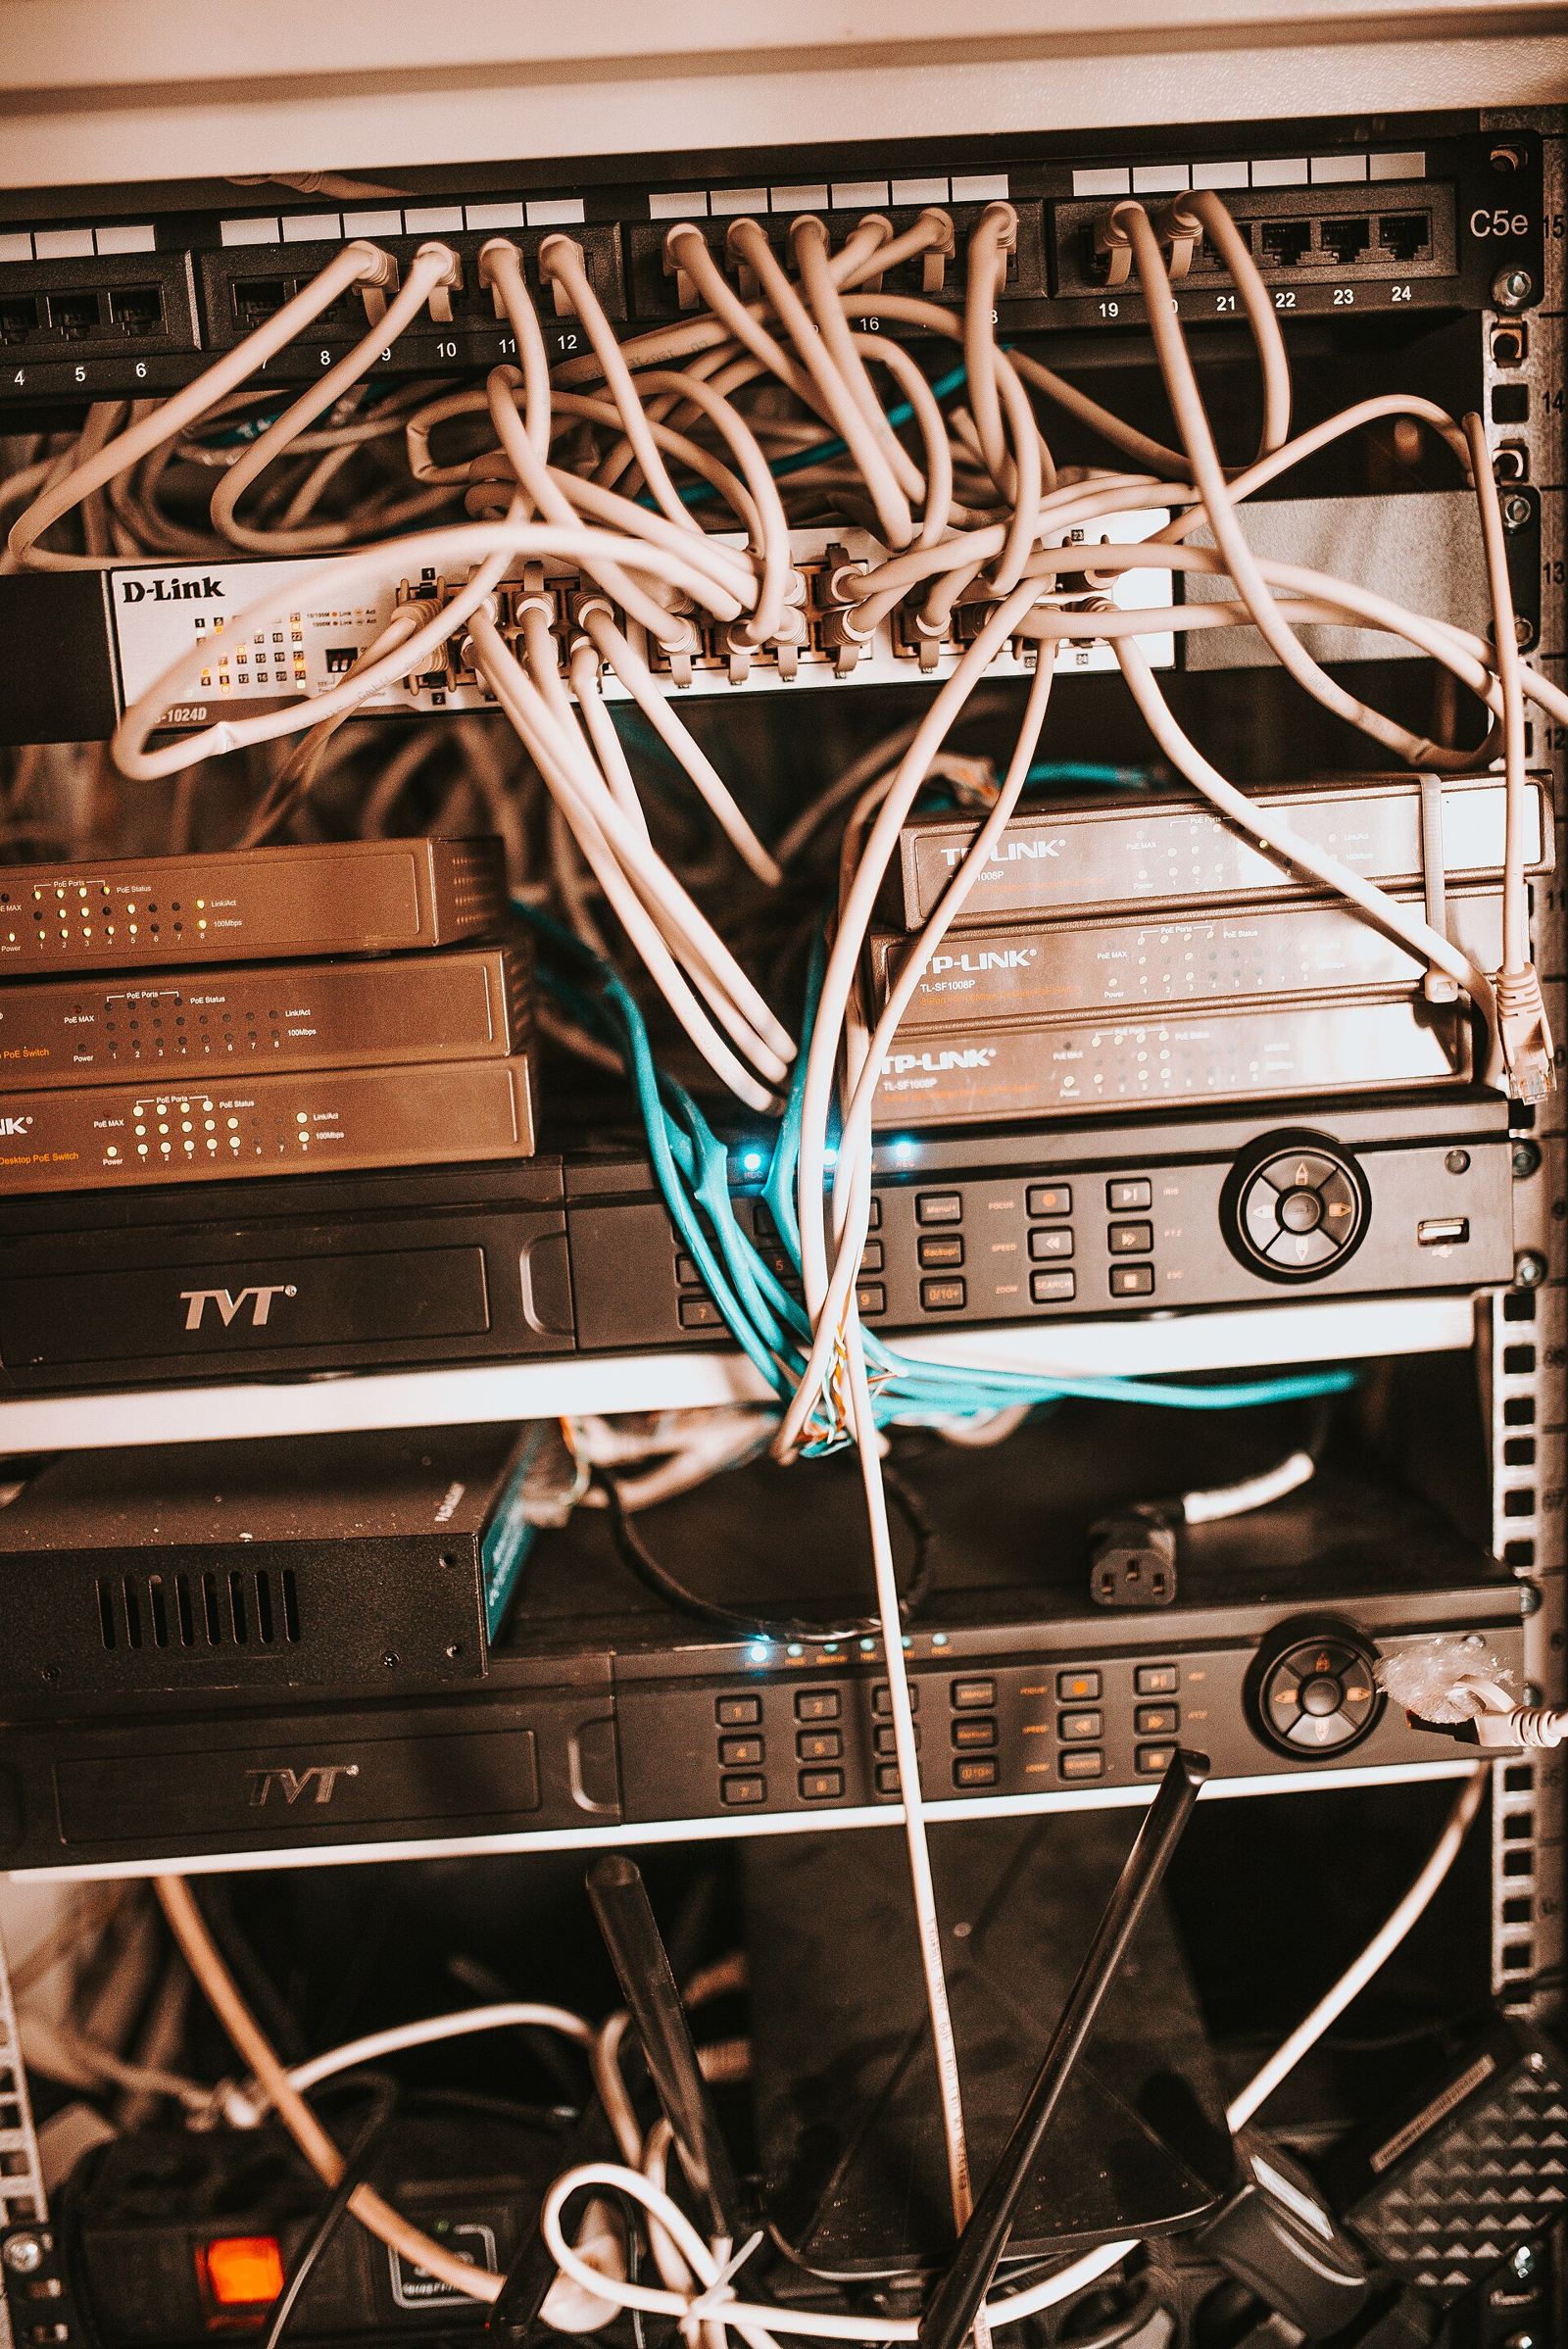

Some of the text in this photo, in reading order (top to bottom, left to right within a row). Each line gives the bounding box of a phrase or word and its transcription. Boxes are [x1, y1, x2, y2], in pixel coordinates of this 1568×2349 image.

[1469, 209, 1529, 238] C5e
[1544, 215, 1565, 239] 15
[1276, 292, 1296, 308] 22
[1334, 289, 1353, 305] 23
[1392, 286, 1411, 302] 24
[1099, 302, 1118, 318] 19
[1216, 296, 1235, 312] 21
[859, 317, 879, 331] 16
[988, 309, 998, 324] 8
[499, 339, 515, 354] 11
[558, 334, 577, 350] 12
[436, 342, 457, 358] 10
[320, 351, 330, 365] 8
[15, 370, 24, 385] 4
[74, 367, 85, 382] 5
[135, 363, 147, 377] 6
[1544, 390, 1565, 411] 14
[1544, 563, 1565, 584] 13
[122, 576, 225, 603] D-Link
[214, 919, 243, 928] 100Mbps
[920, 980, 975, 993] TL-SF1008P
[3, 1048, 50, 1059] PoE Switch
[52, 1151, 79, 1161] Switch
[988, 1201, 1014, 1210] FOCUS
[774, 1260, 784, 1271] 5
[996, 1285, 1018, 1295] ZOOM
[1035, 1279, 1071, 1292] SEARCH
[860, 1294, 870, 1306] 9
[179, 1285, 285, 1331] TVT
[733, 1706, 742, 1718] 1
[245, 1767, 349, 1805] TVT
